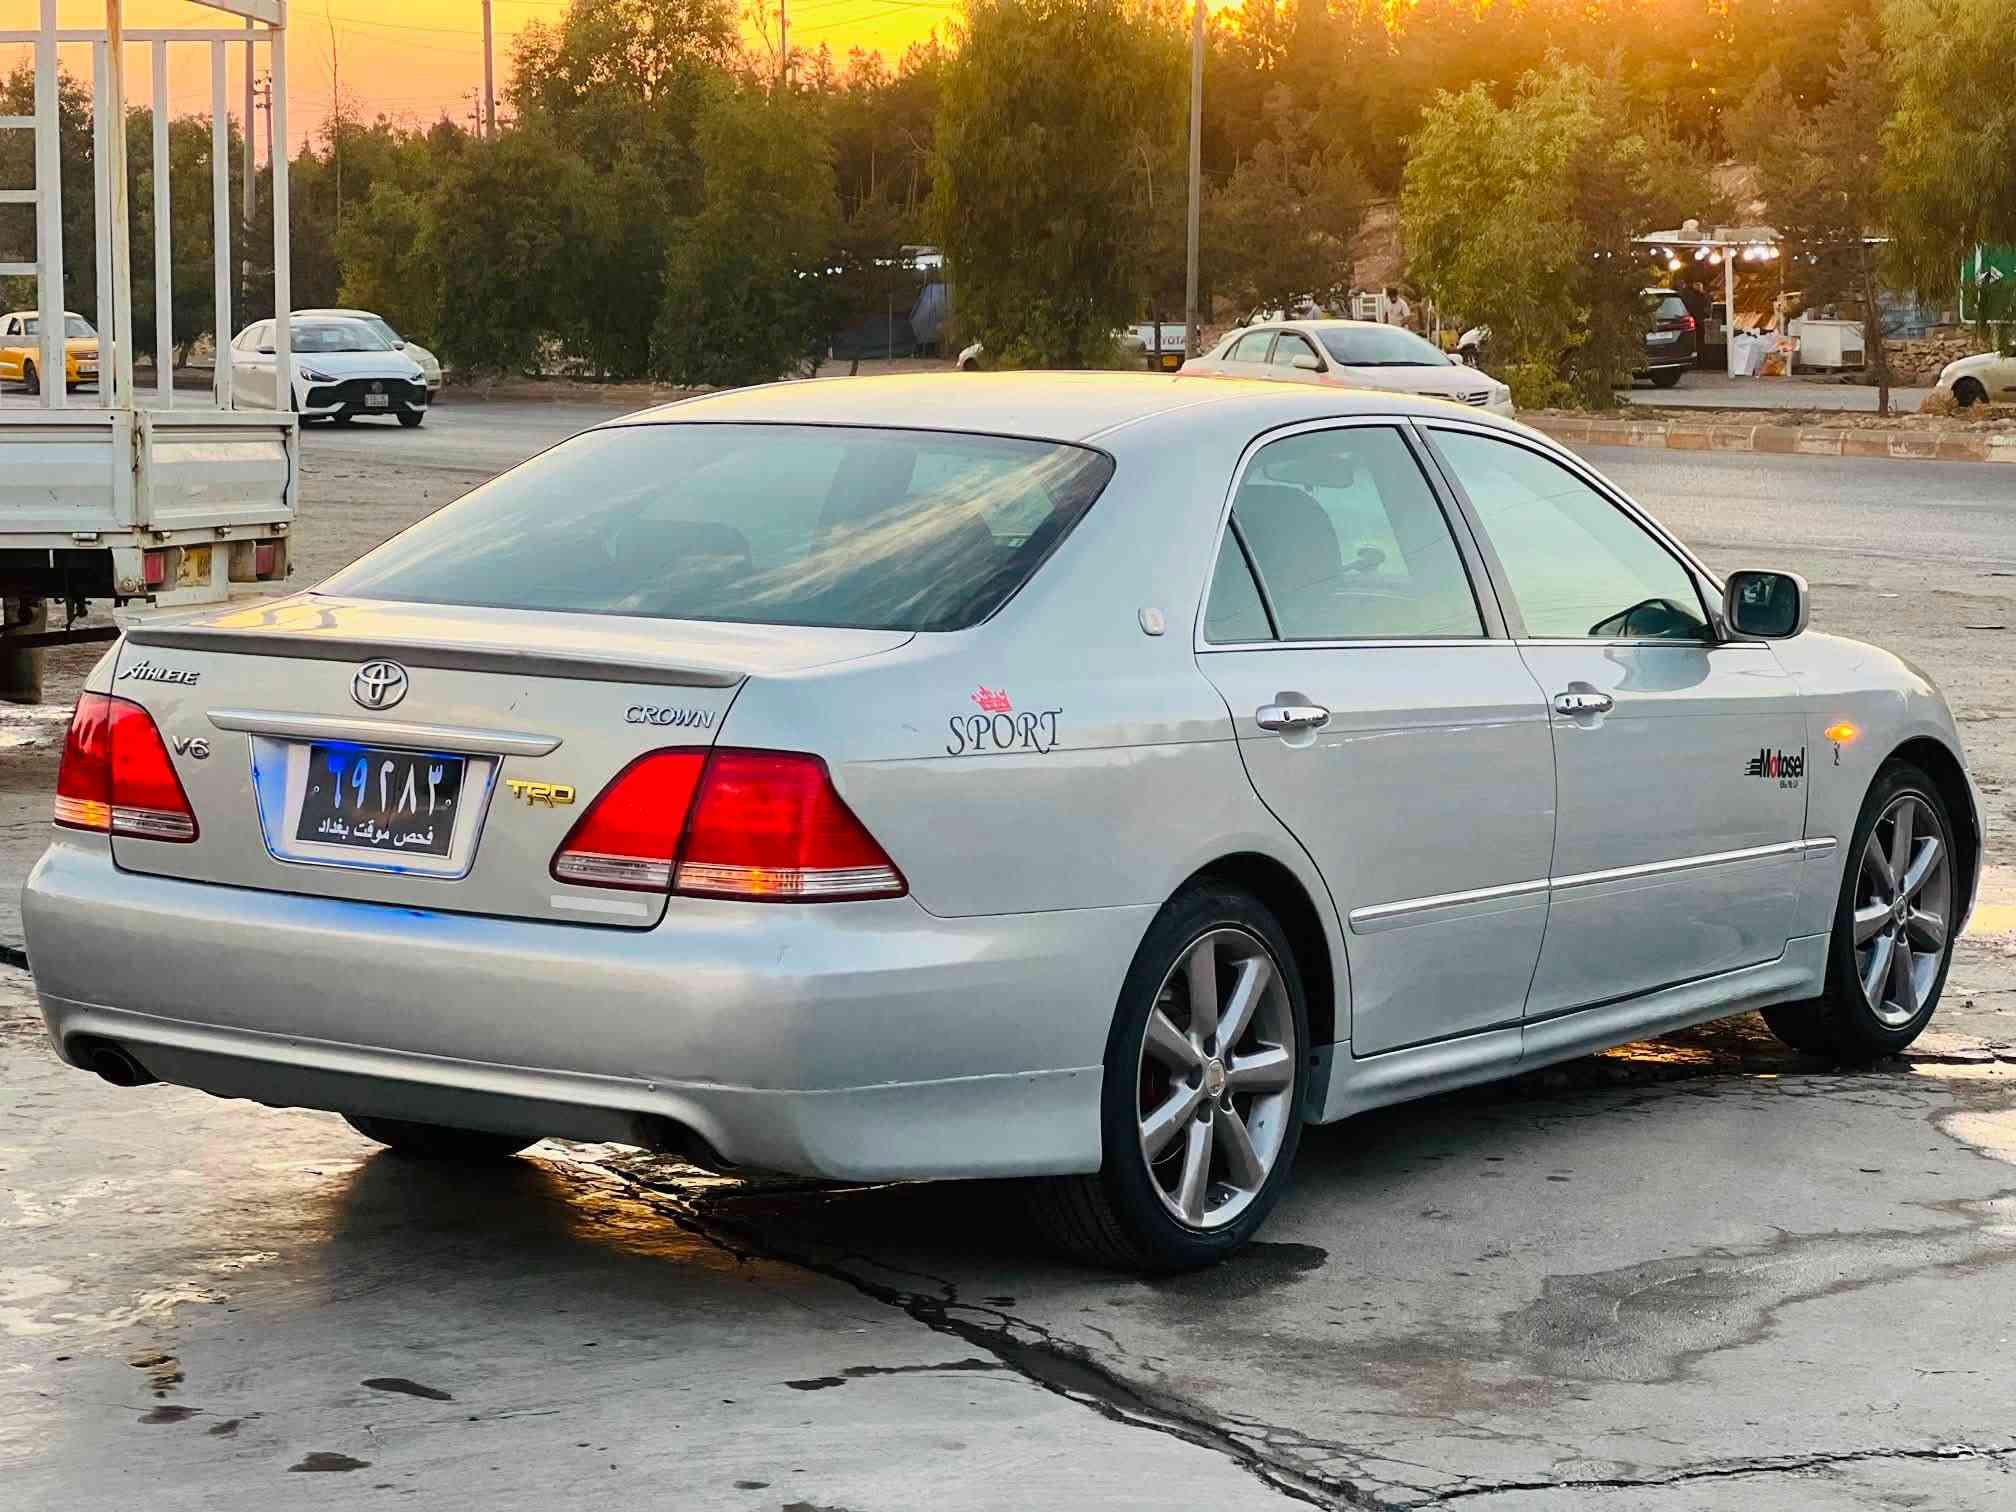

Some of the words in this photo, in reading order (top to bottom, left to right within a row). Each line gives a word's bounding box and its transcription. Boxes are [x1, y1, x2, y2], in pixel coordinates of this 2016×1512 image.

[118, 660, 201, 687] ATHLETE
[624, 704, 715, 729] CROWN
[946, 707, 1064, 755] SPORT
[172, 735, 210, 760] V6
[1759, 746, 1805, 778] Motosel
[506, 777, 577, 808] TRD
[318, 817, 349, 839] بغداد
[353, 819, 390, 843] موقت
[393, 825, 434, 847] فحص
